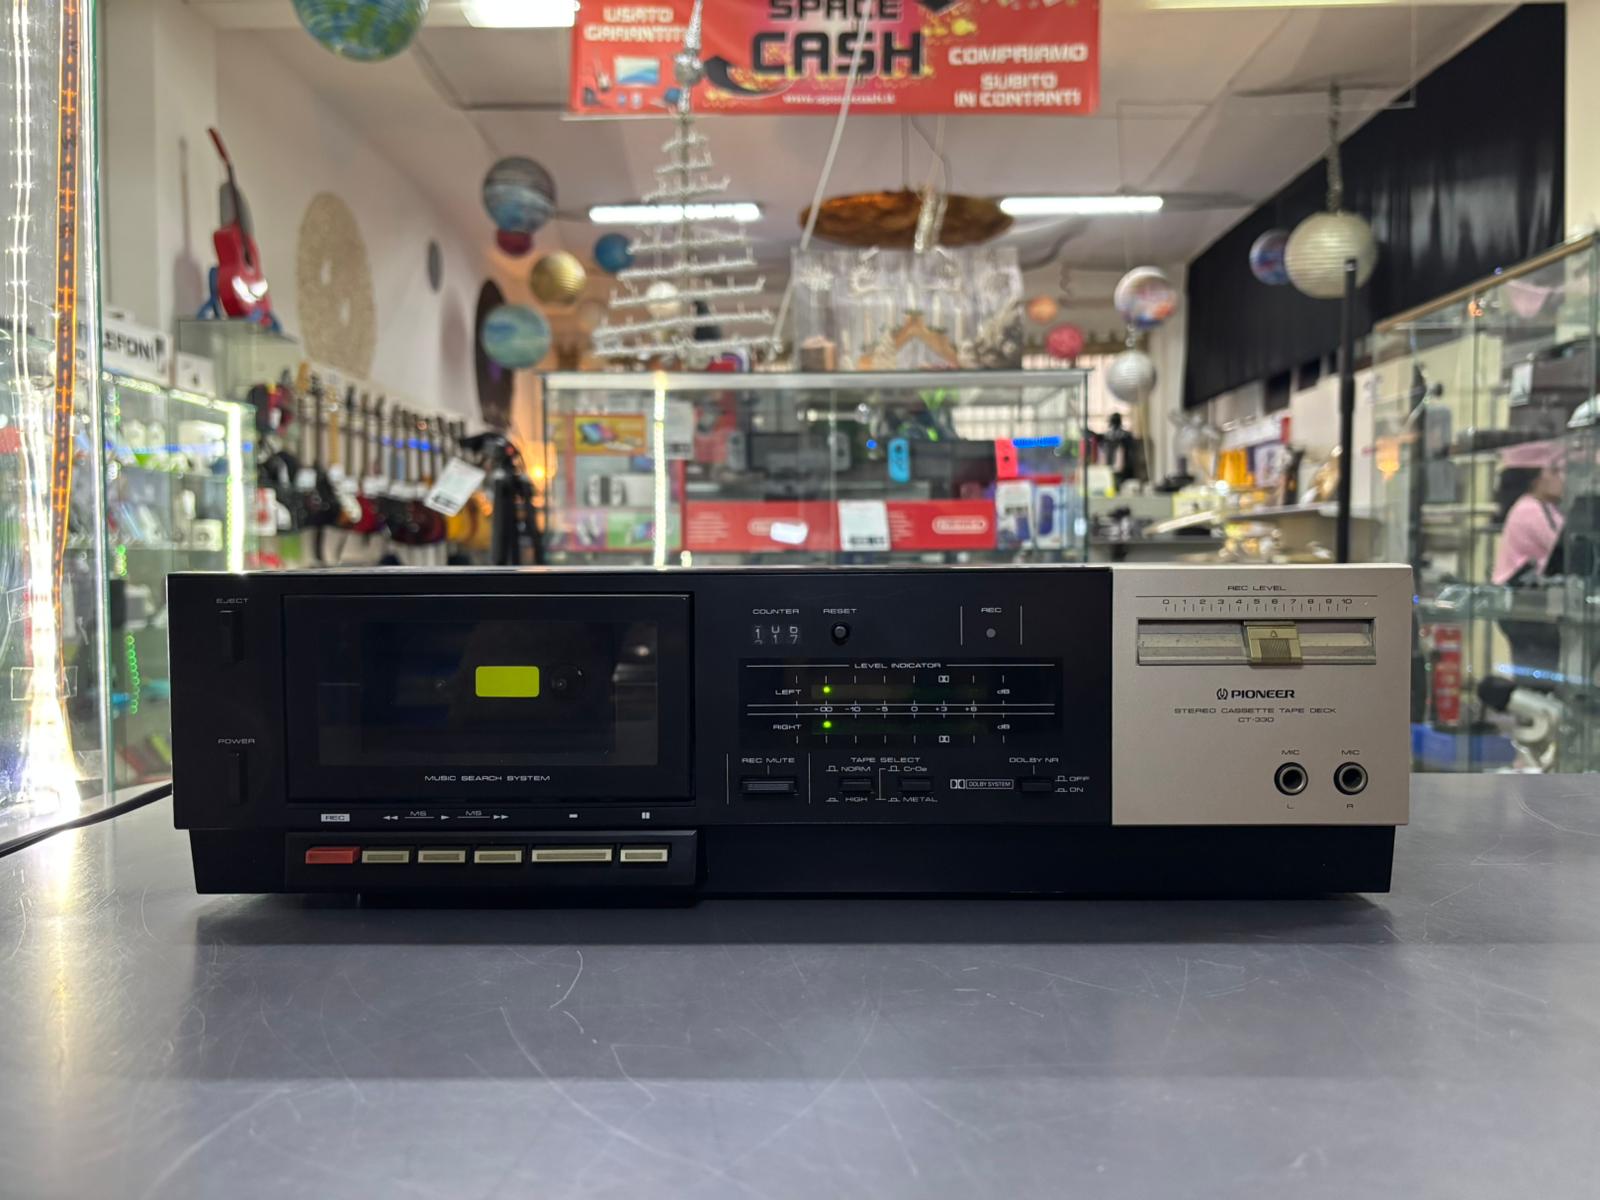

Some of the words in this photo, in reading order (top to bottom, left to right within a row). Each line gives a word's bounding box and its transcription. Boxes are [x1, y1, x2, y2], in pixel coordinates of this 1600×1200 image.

[603, 8, 674, 22] USATO
[753, 31, 922, 75] CASH
[948, 44, 1089, 65] COMPRIAMO
[980, 73, 1058, 90] SUBITO
[954, 90, 977, 107] IN
[979, 89, 1082, 107] CONTANTI
[215, 597, 249, 605] EJECT
[980, 606, 1002, 614] REC
[775, 688, 802, 696] LEFT
[1230, 689, 1295, 699] PIONEER
[772, 723, 802, 731] RIGHT
[850, 756, 876, 764] TAPE
[879, 756, 921, 764] SELECT
[1008, 756, 1043, 764] DOLBY
[1044, 756, 1059, 764] NR
[324, 814, 346, 822] REC
